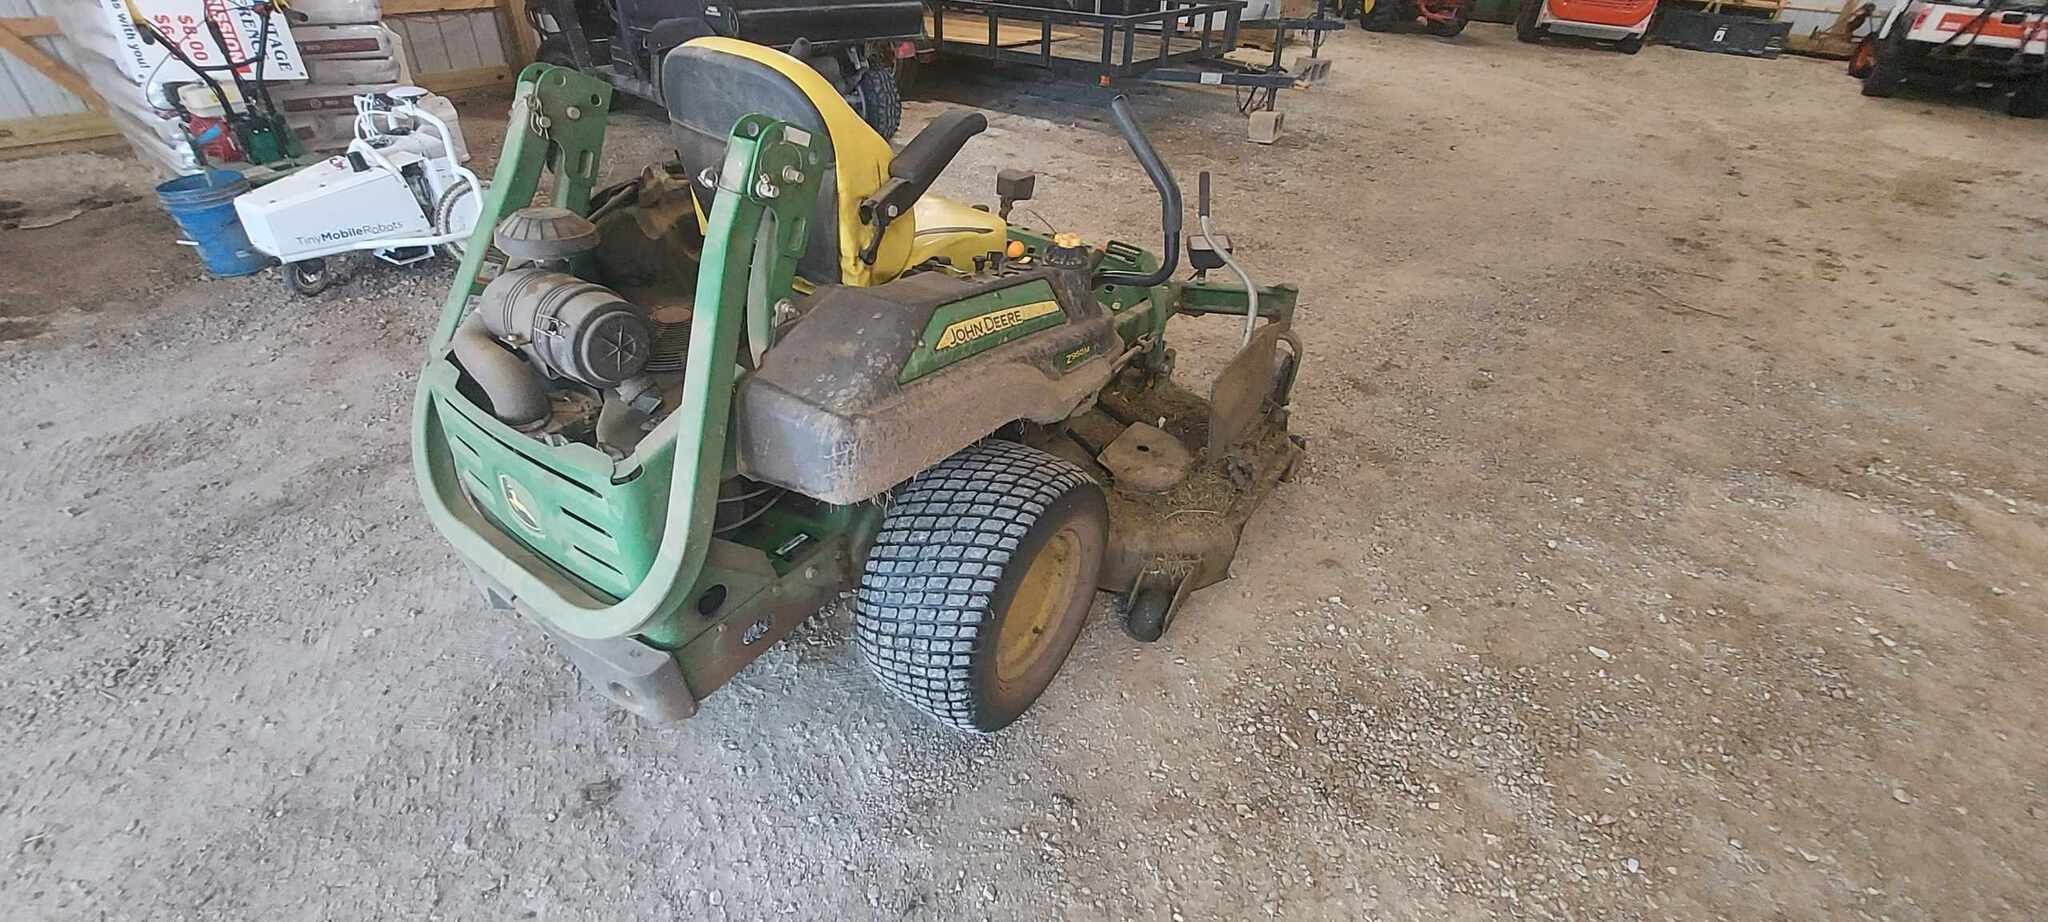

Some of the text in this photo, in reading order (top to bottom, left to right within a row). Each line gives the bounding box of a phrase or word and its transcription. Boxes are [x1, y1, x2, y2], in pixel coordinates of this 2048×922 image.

[118, 13, 136, 40] with
[128, 43, 151, 69] you!
[178, 16, 208, 60] $8.00
[295, 222, 403, 247] TinyMobileRobots
[950, 310, 1023, 345] JOHN DEERE
